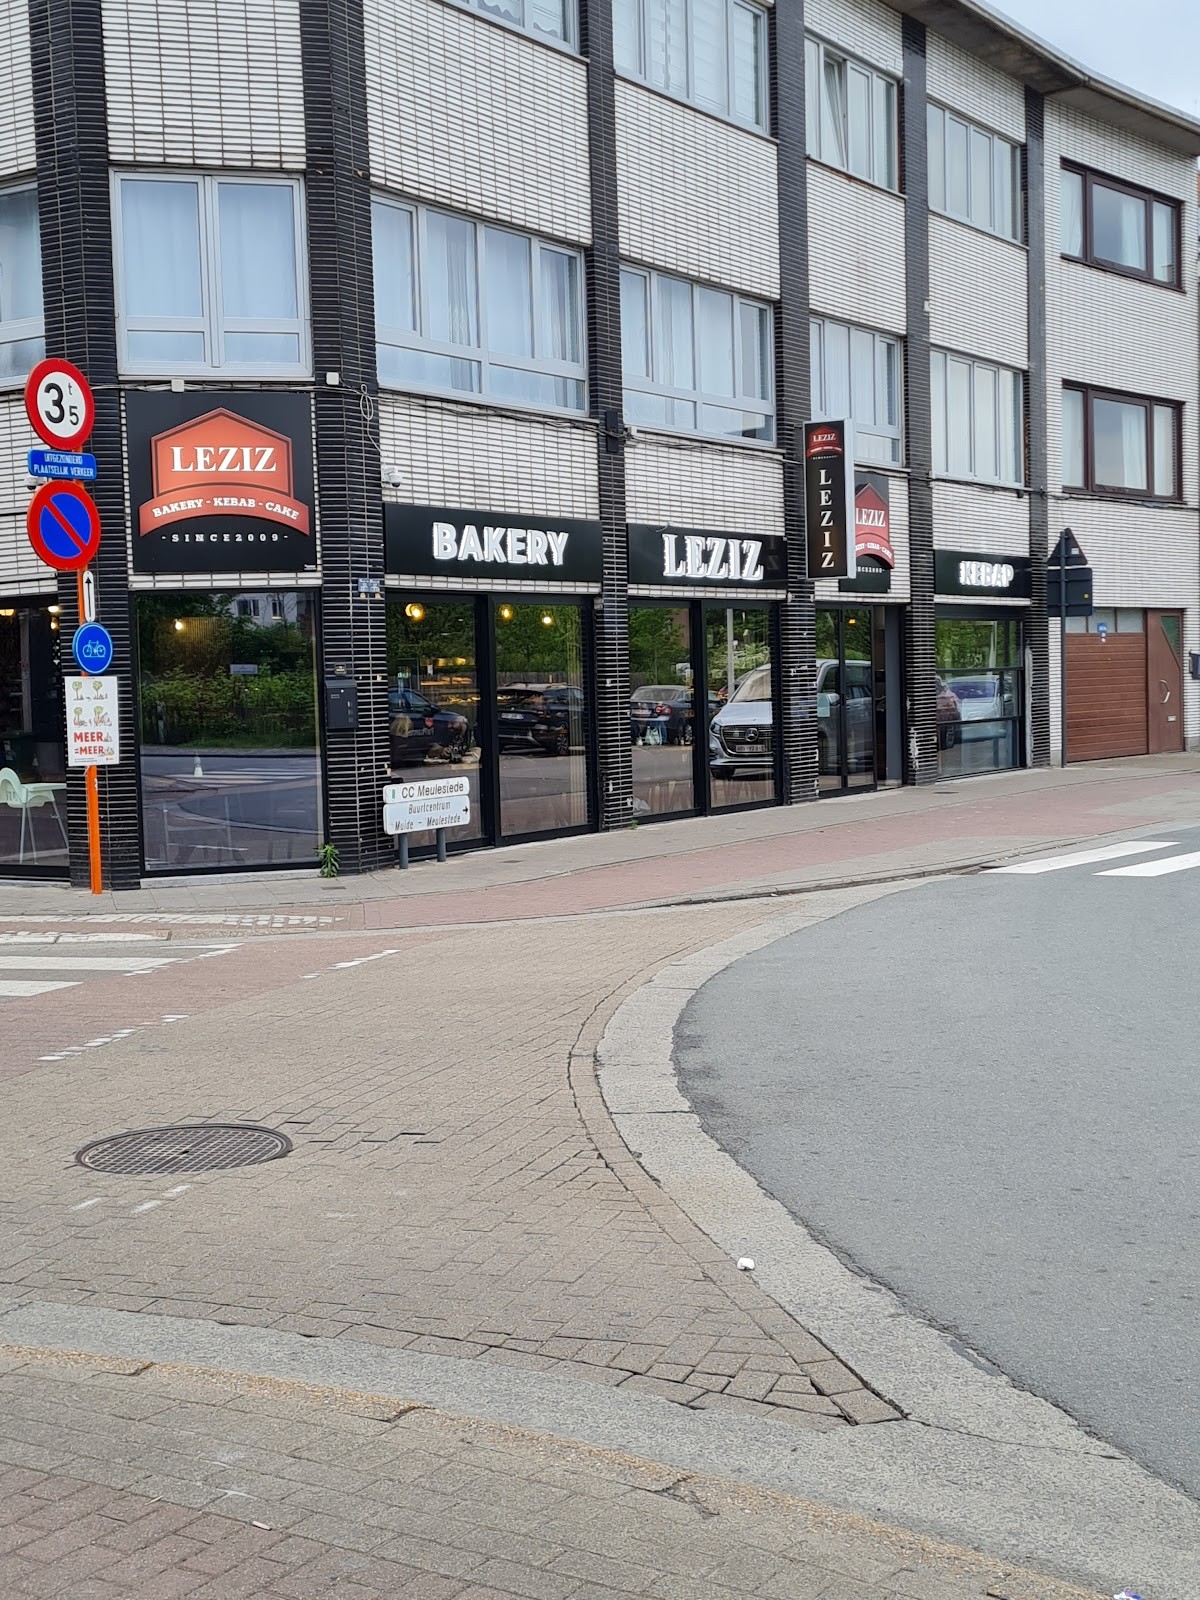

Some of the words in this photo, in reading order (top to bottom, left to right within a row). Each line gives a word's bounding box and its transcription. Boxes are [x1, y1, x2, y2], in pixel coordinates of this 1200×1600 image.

[813, 433, 836, 442] LEZIZ
[44, 452, 83, 465] UITGEZONDERD
[170, 446, 277, 472] LEZIZ
[33, 463, 69, 476] PLAATSELIJK
[70, 466, 95, 478] VERKEER
[152, 499, 204, 518] BAKERY
[213, 497, 256, 508] KEBAB
[265, 501, 300, 521] CAKE
[819, 469, 835, 568] LEZIZ
[855, 507, 886, 528] LEZIZ
[432, 522, 569, 565] BAKERY
[662, 534, 764, 580] LEZIZ
[959, 561, 1015, 588] KEBAP
[74, 732, 104, 743] MEER
[402, 786, 415, 798] CC
[417, 782, 464, 797] Meulestede
[409, 802, 450, 814] Buurtcentrum
[395, 820, 414, 831] Muide
[427, 813, 460, 827] Meulestede
